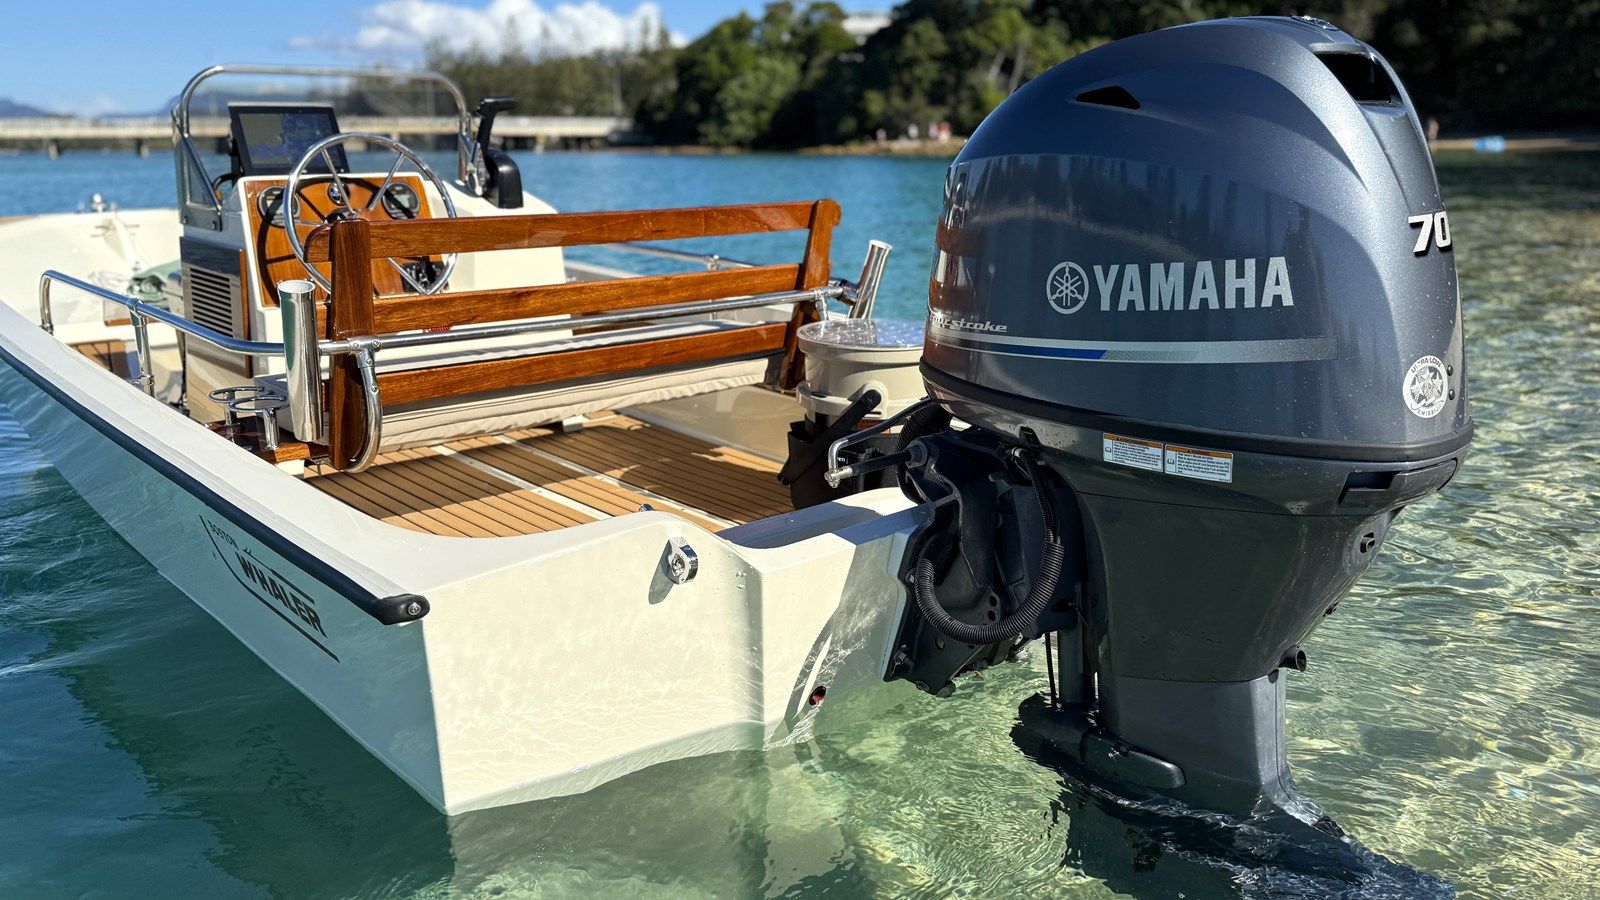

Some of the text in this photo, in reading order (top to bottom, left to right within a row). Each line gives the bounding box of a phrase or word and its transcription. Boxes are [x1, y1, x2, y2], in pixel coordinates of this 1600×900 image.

[1408, 211, 1452, 253] 70
[1093, 256, 1294, 311] YAMAHA
[207, 520, 240, 551] BOSTON
[234, 551, 328, 639] WHALER
